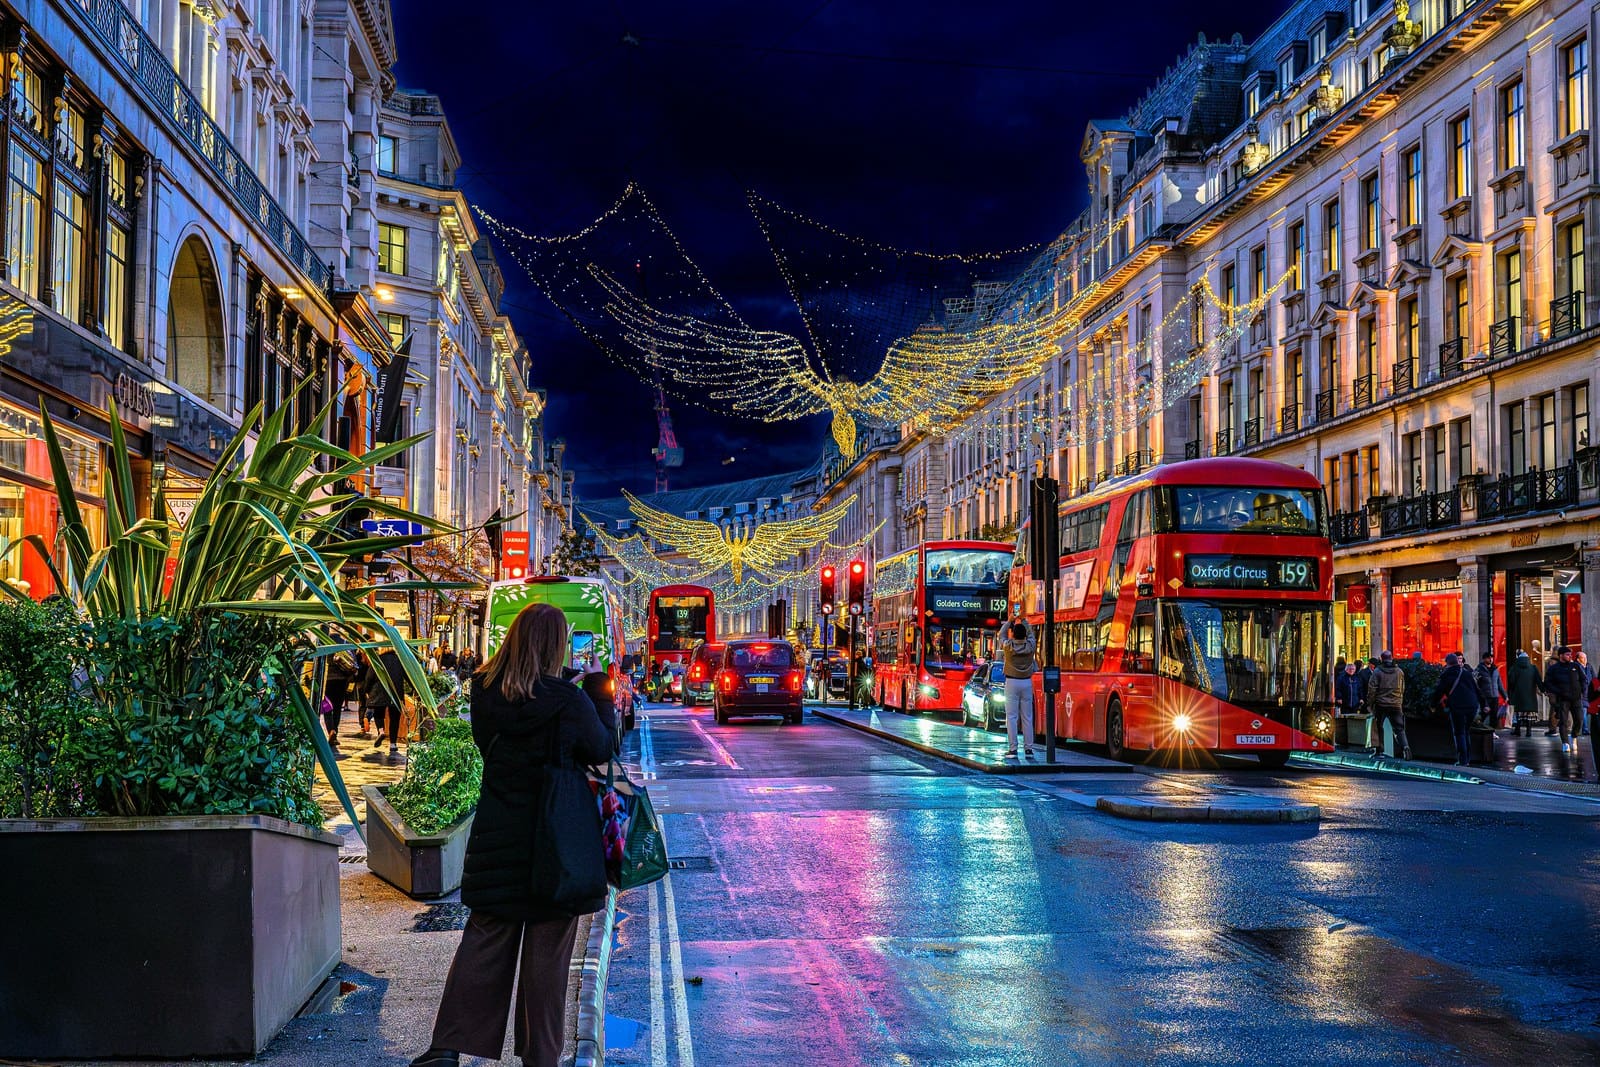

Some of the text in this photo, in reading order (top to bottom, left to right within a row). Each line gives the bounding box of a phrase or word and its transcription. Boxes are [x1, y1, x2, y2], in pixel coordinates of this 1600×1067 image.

[118, 372, 155, 418] GUESS
[375, 374, 388, 433] Massimo Dutti
[170, 500, 196, 508] GUESS
[1191, 563, 1307, 584] Oxford Circus 159
[936, 599, 1007, 611] Golders Green 139
[676, 609, 688, 618] 139
